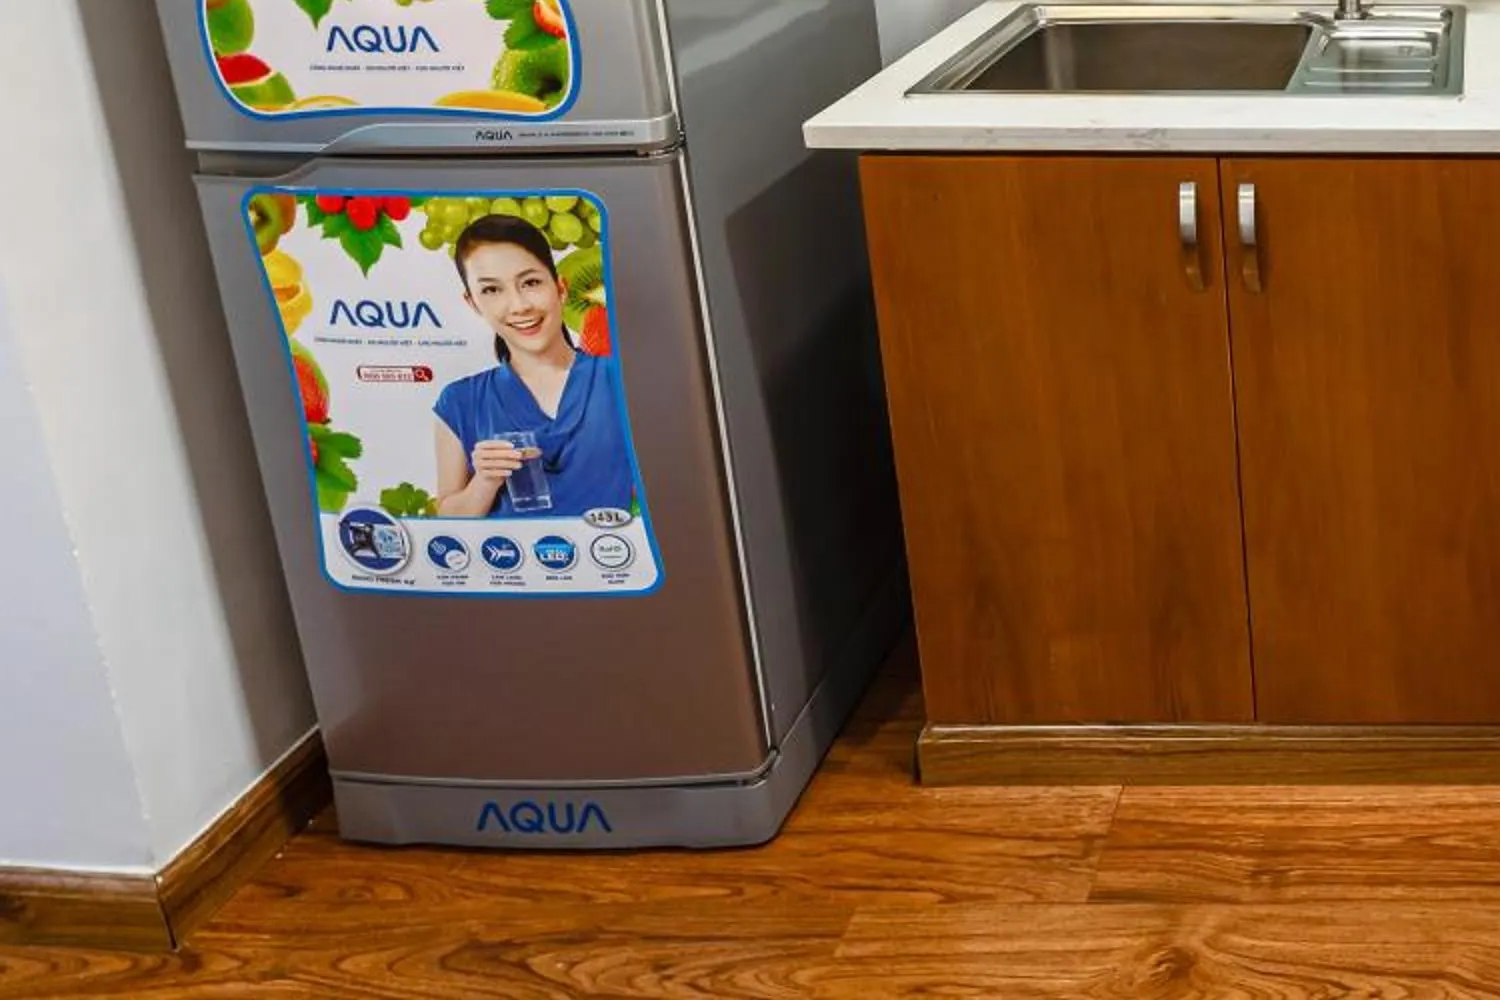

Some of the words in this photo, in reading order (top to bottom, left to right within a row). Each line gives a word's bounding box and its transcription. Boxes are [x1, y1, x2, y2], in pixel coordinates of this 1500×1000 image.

[326, 25, 440, 52] AQUA
[475, 130, 512, 141] AQUA
[330, 299, 442, 328] AQUA
[477, 802, 612, 833] AQUA
